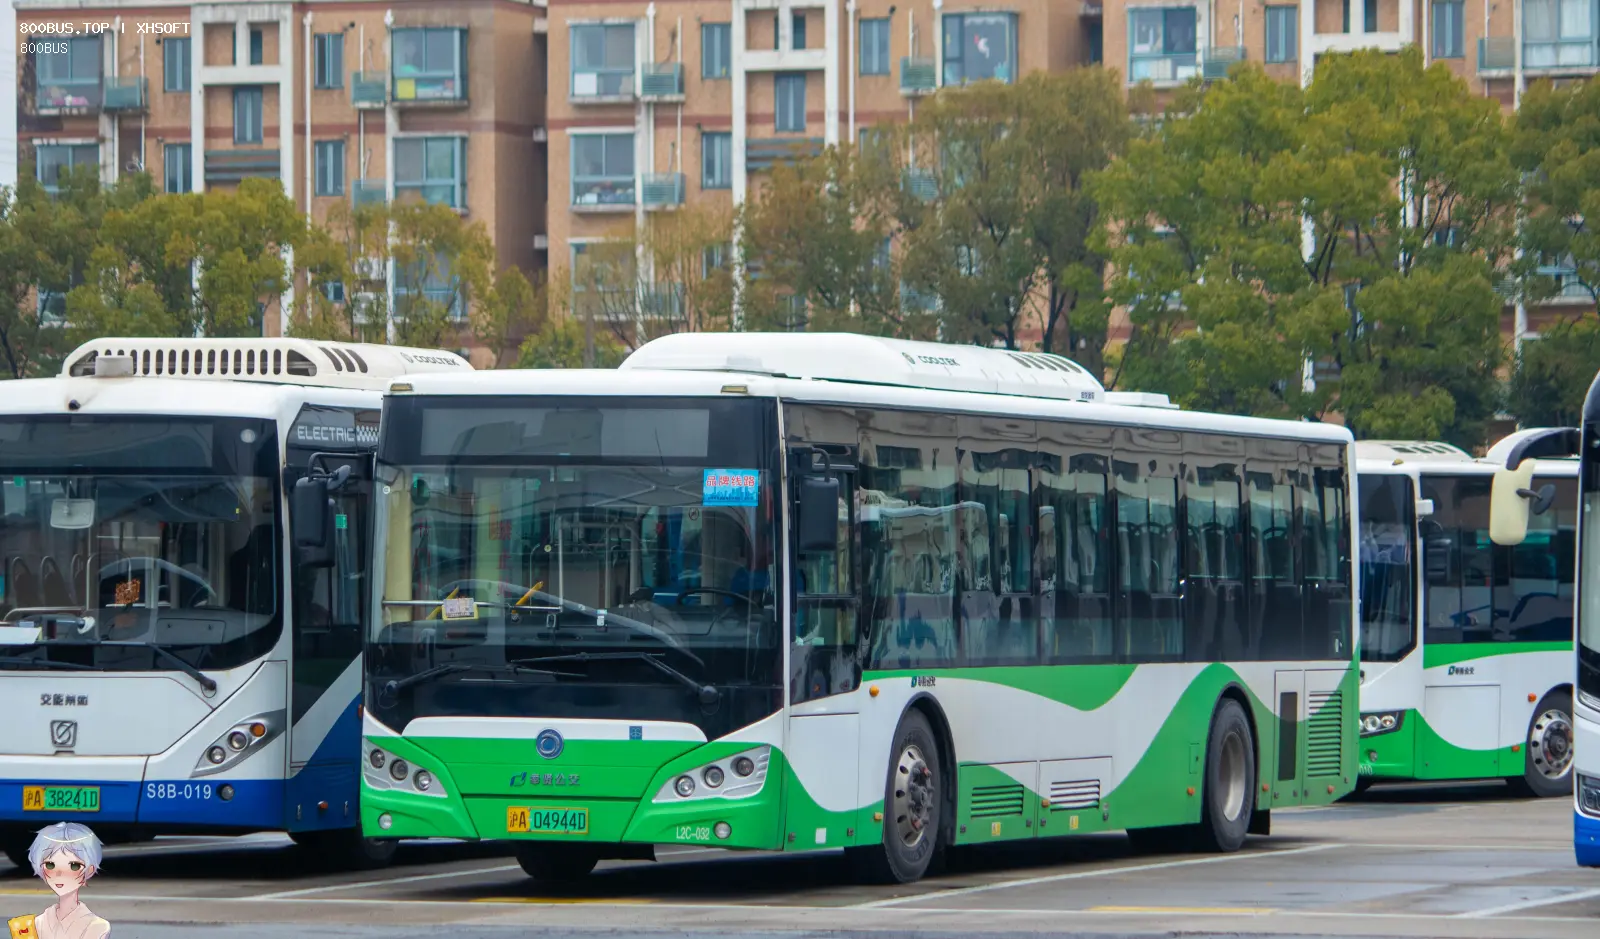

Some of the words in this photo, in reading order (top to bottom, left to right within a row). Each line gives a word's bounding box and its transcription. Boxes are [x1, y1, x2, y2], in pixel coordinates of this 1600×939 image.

[412, 355, 460, 367] COOLTEK
[917, 355, 961, 367] COOLTEK
[297, 425, 355, 442] ELECTRIC
[706, 475, 755, 487] 品牌线路
[147, 783, 211, 799] S8B-019
[676, 825, 710, 840] L2C-032
